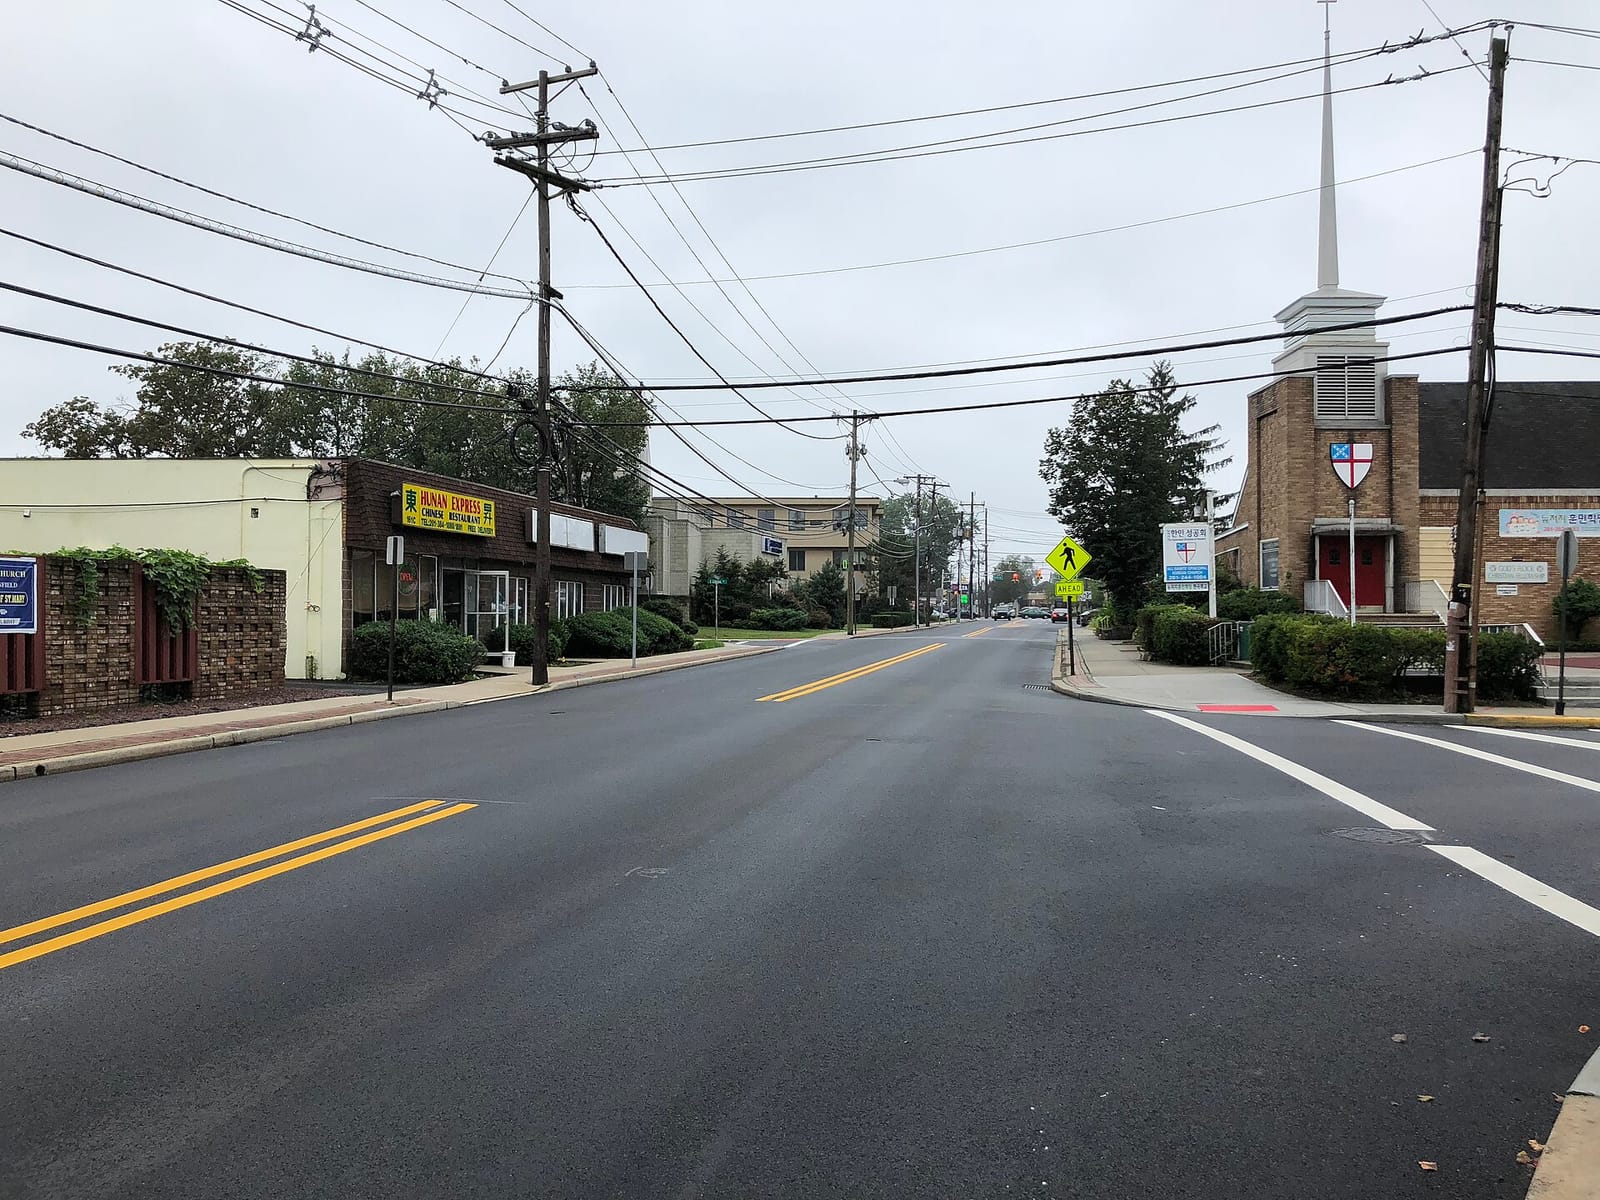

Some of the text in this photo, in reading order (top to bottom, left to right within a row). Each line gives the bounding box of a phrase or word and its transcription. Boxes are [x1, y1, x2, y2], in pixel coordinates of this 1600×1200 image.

[405, 489, 417, 512] 東
[421, 490, 481, 514] HUNAN EXPRESS
[422, 508, 480, 524] CHINESE RESTAURANT
[1568, 513, 1600, 525] 훈민학
[1170, 528, 1184, 538] 한인
[1186, 528, 1206, 537] 성공회
